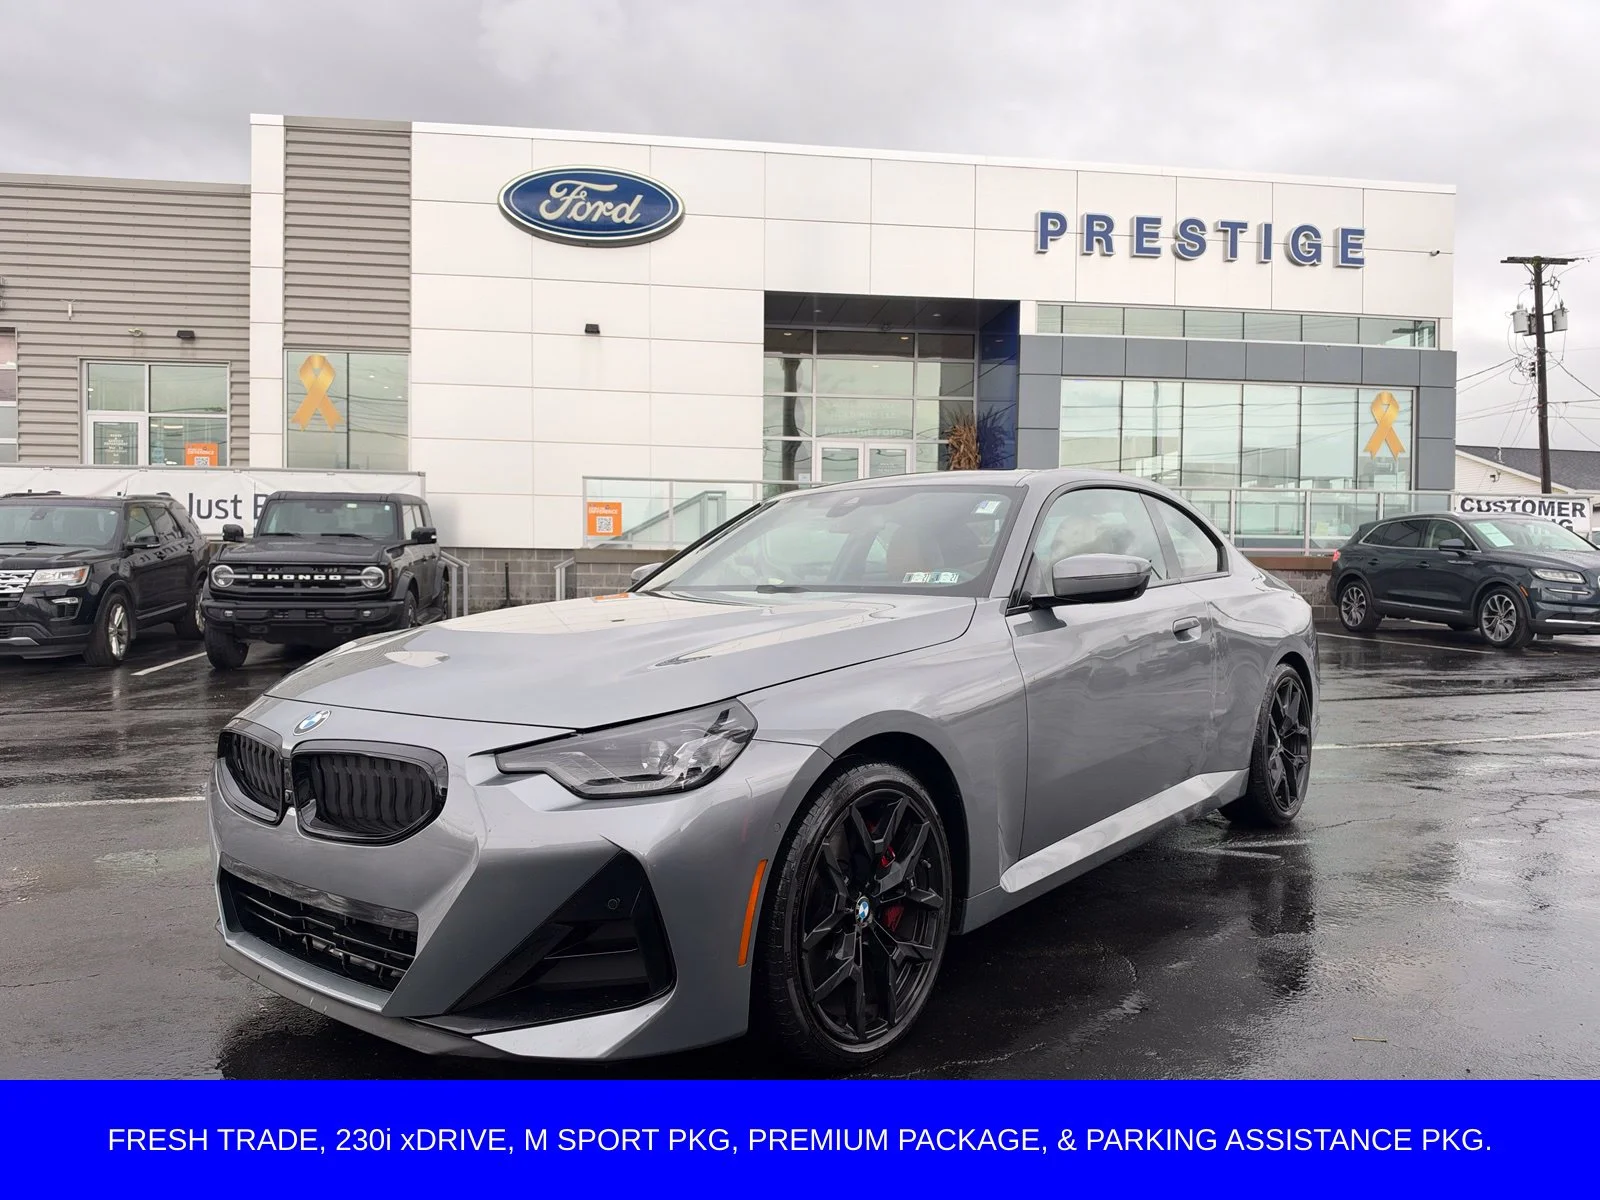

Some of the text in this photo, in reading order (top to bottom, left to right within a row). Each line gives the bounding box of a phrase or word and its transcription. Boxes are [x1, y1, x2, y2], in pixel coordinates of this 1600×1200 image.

[539, 179, 643, 224] Ford
[1035, 210, 1366, 268] PRESTIGE
[188, 492, 243, 520] Just
[1460, 497, 1586, 518] CUSTOMER
[251, 573, 342, 581] BRONCO
